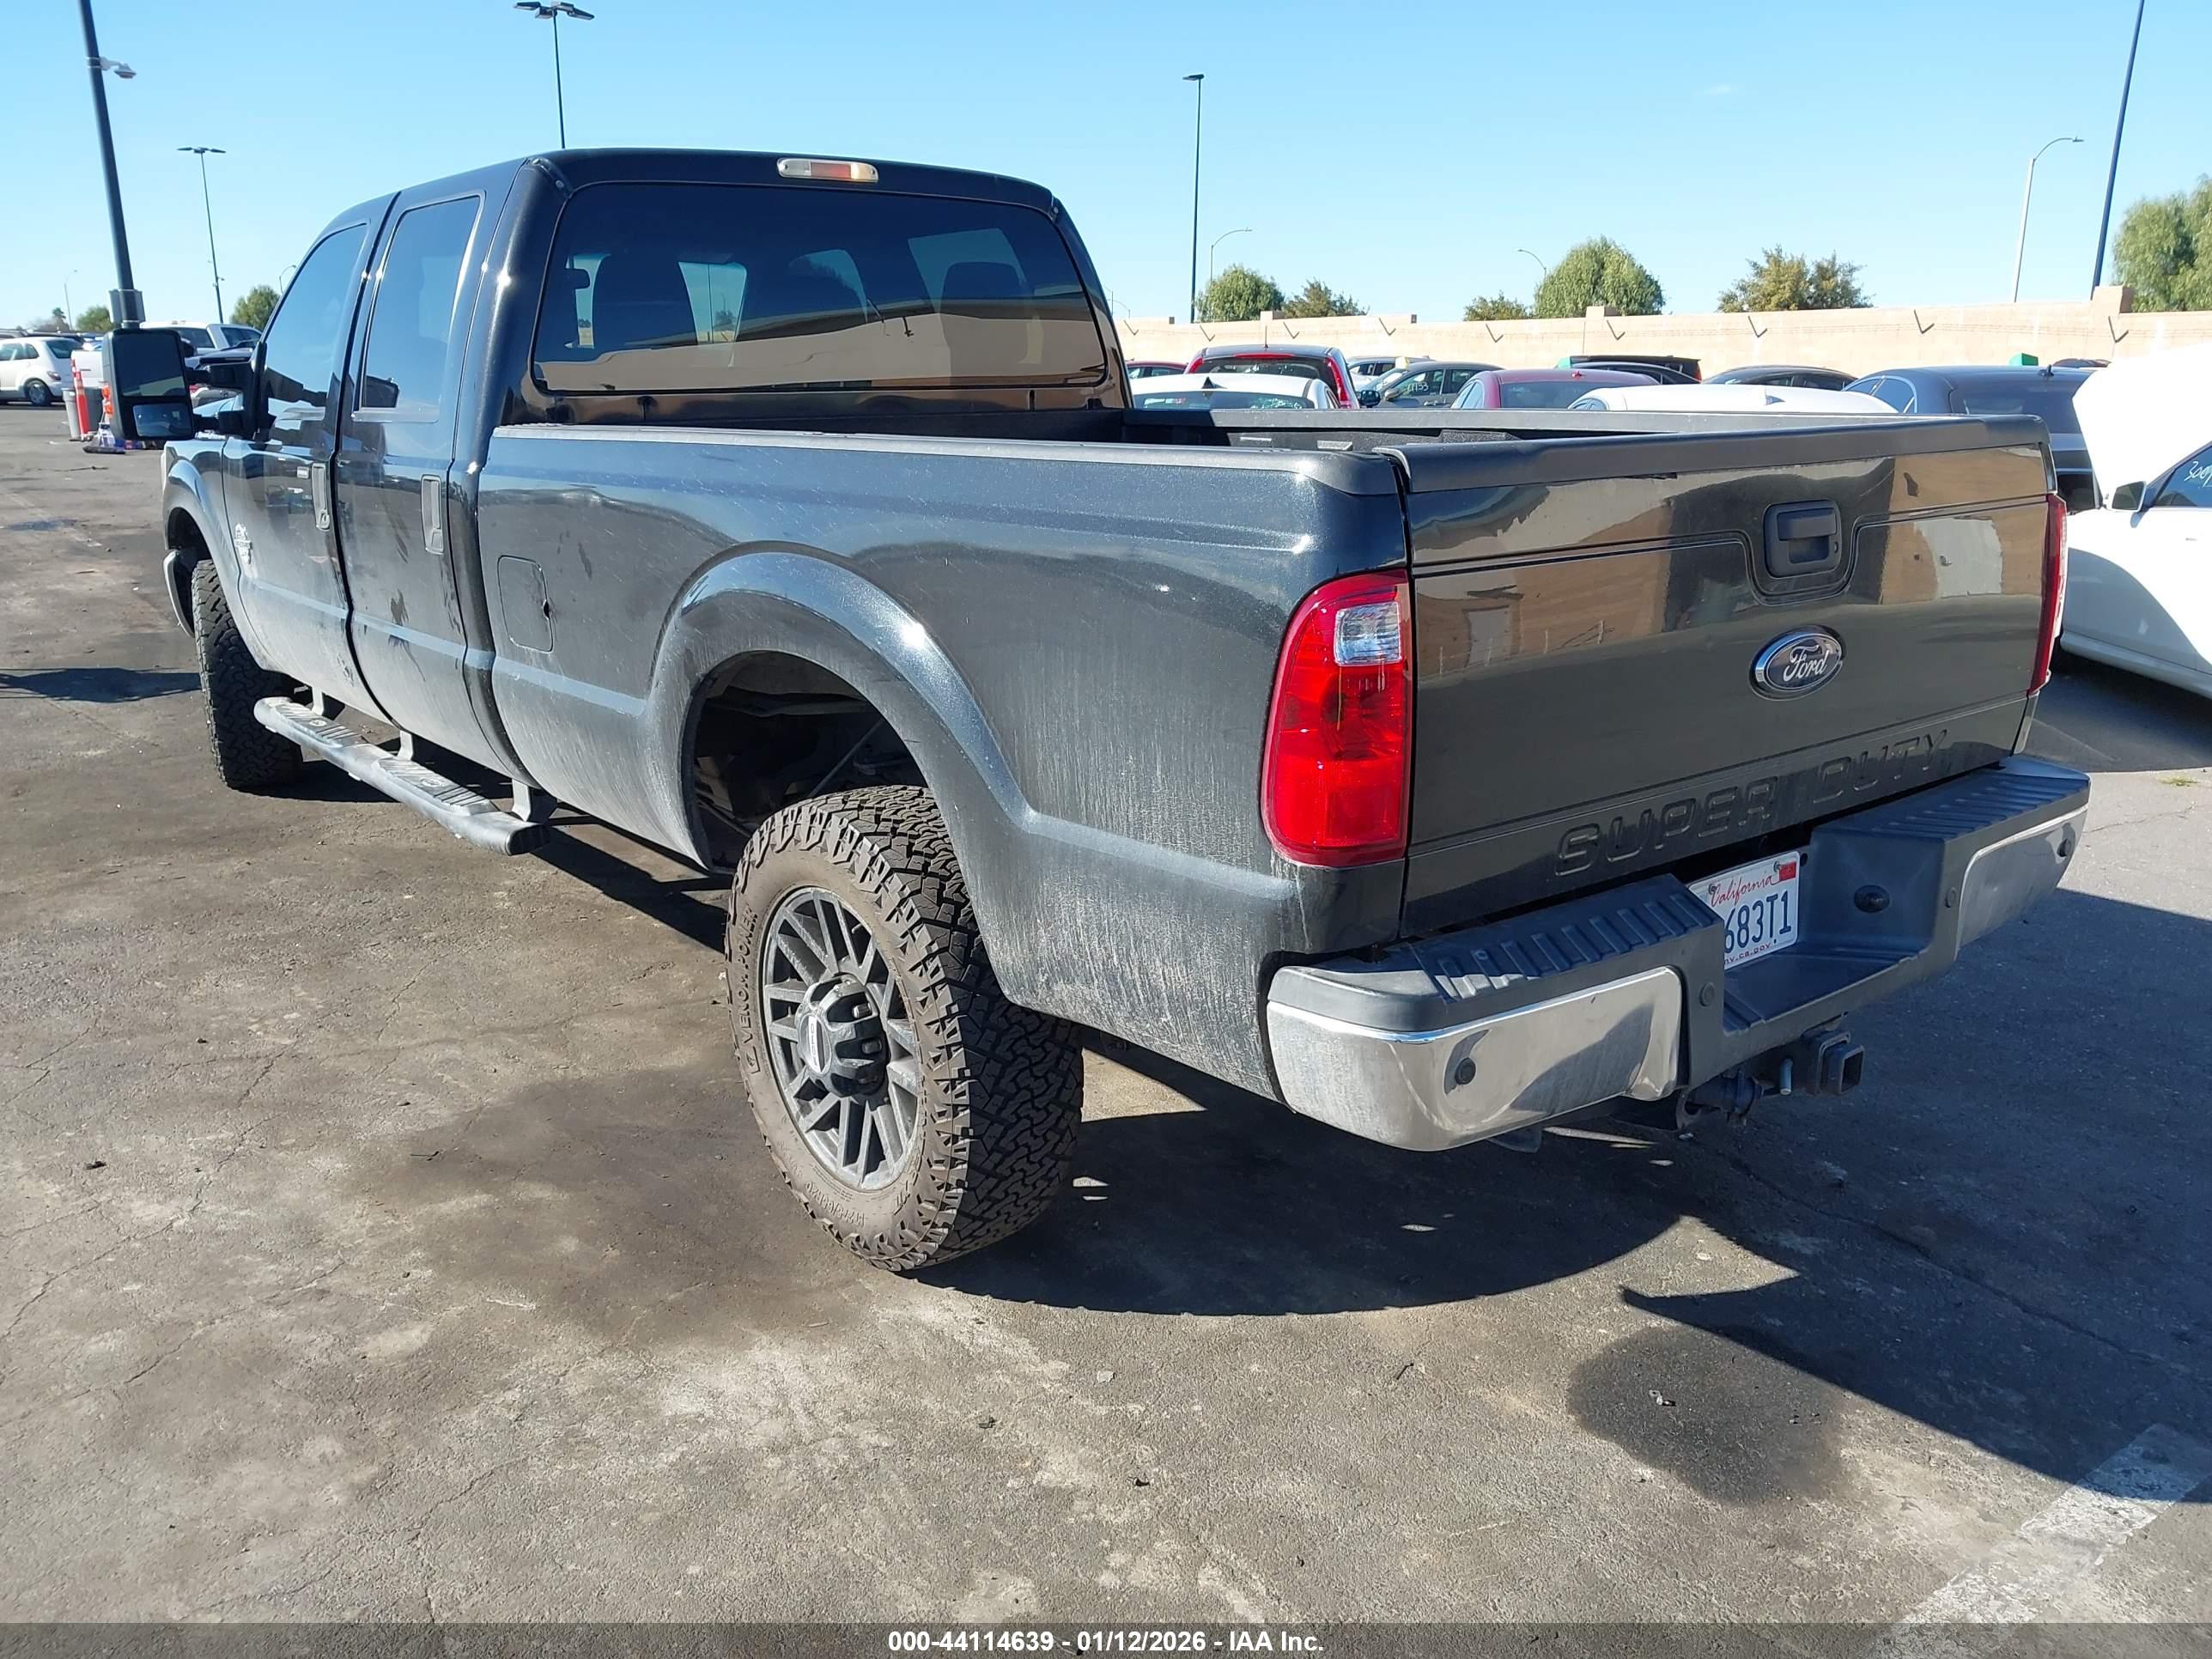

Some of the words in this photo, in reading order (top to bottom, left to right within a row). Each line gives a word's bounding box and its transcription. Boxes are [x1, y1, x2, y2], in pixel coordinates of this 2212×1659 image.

[1783, 644, 1829, 682] Ford
[1553, 775, 1779, 877] SUPER
[1813, 728, 1948, 804] DUTY
[1711, 873, 1779, 908] California
